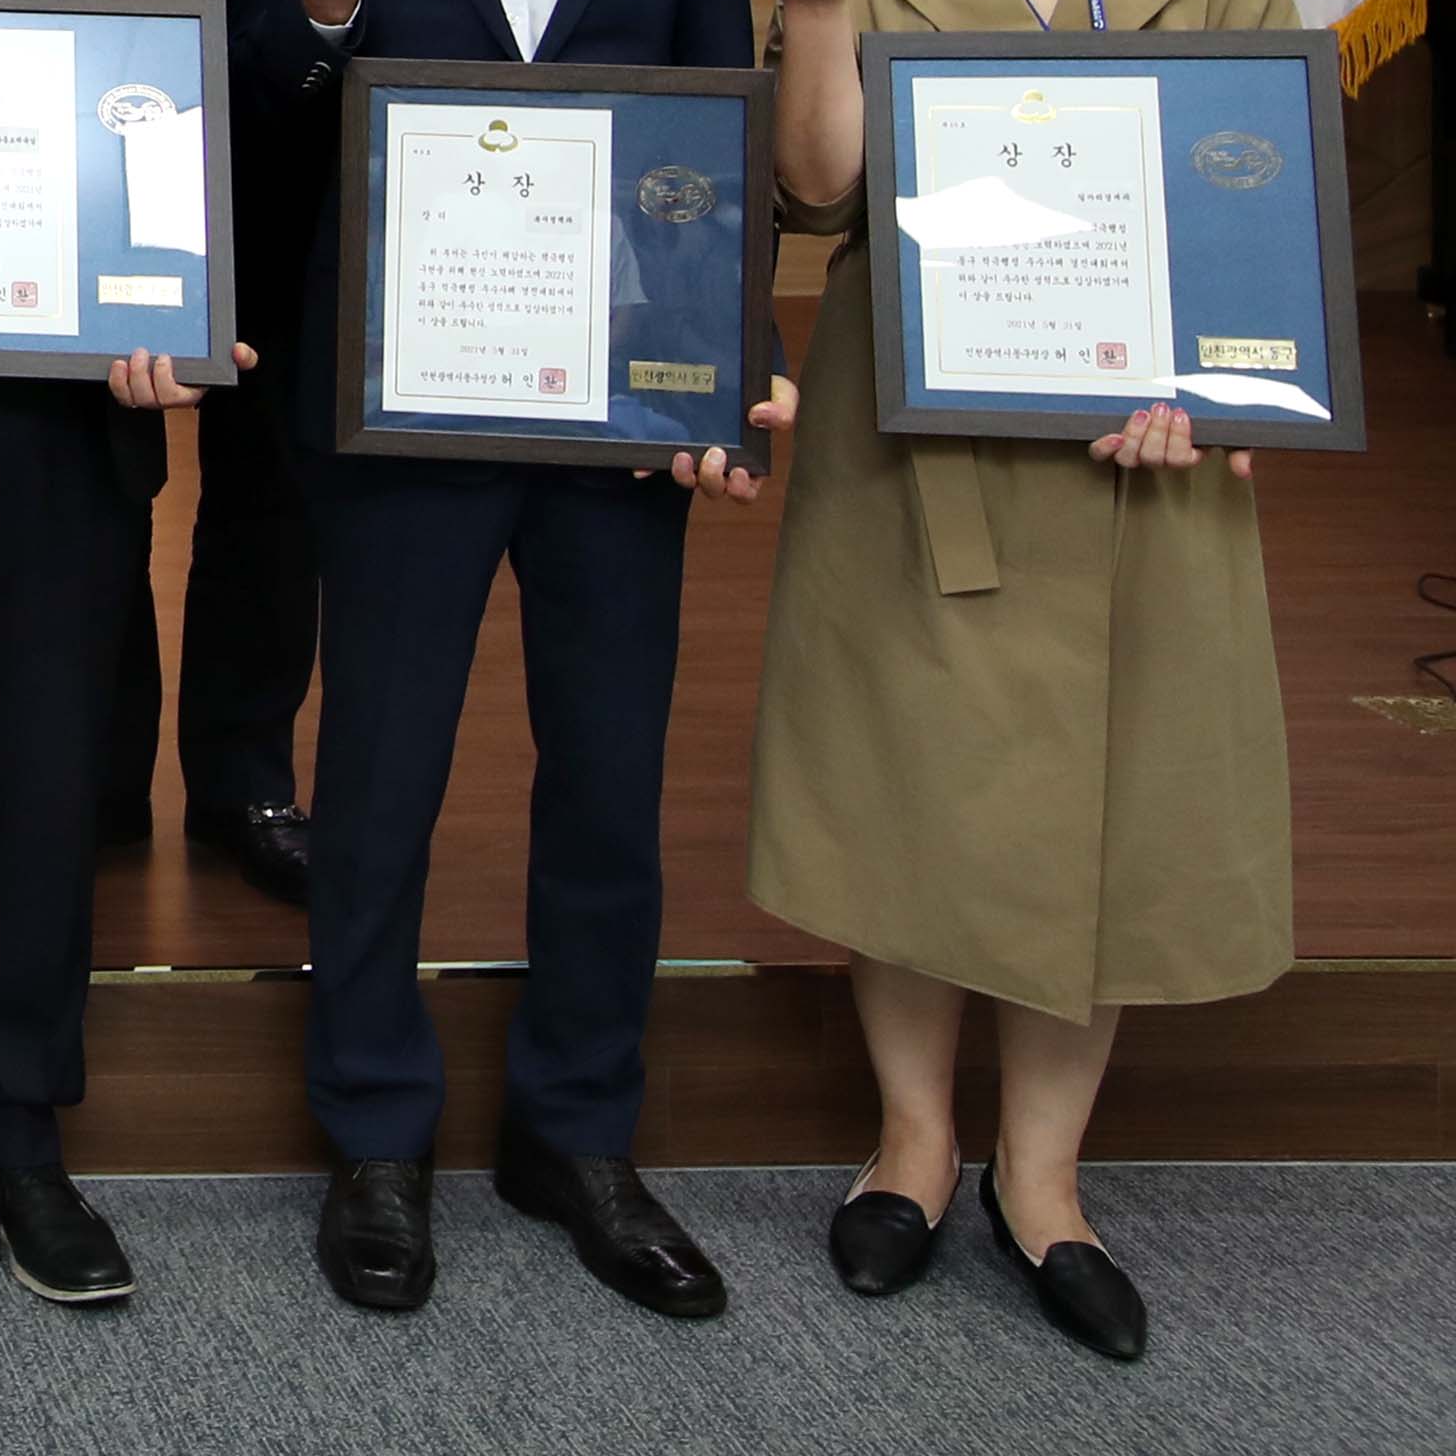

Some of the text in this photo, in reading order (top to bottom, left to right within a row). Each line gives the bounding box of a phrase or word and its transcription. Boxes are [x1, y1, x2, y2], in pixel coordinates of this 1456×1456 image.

[999, 142, 1077, 169] 상 장
[463, 170, 535, 199] 상 장
